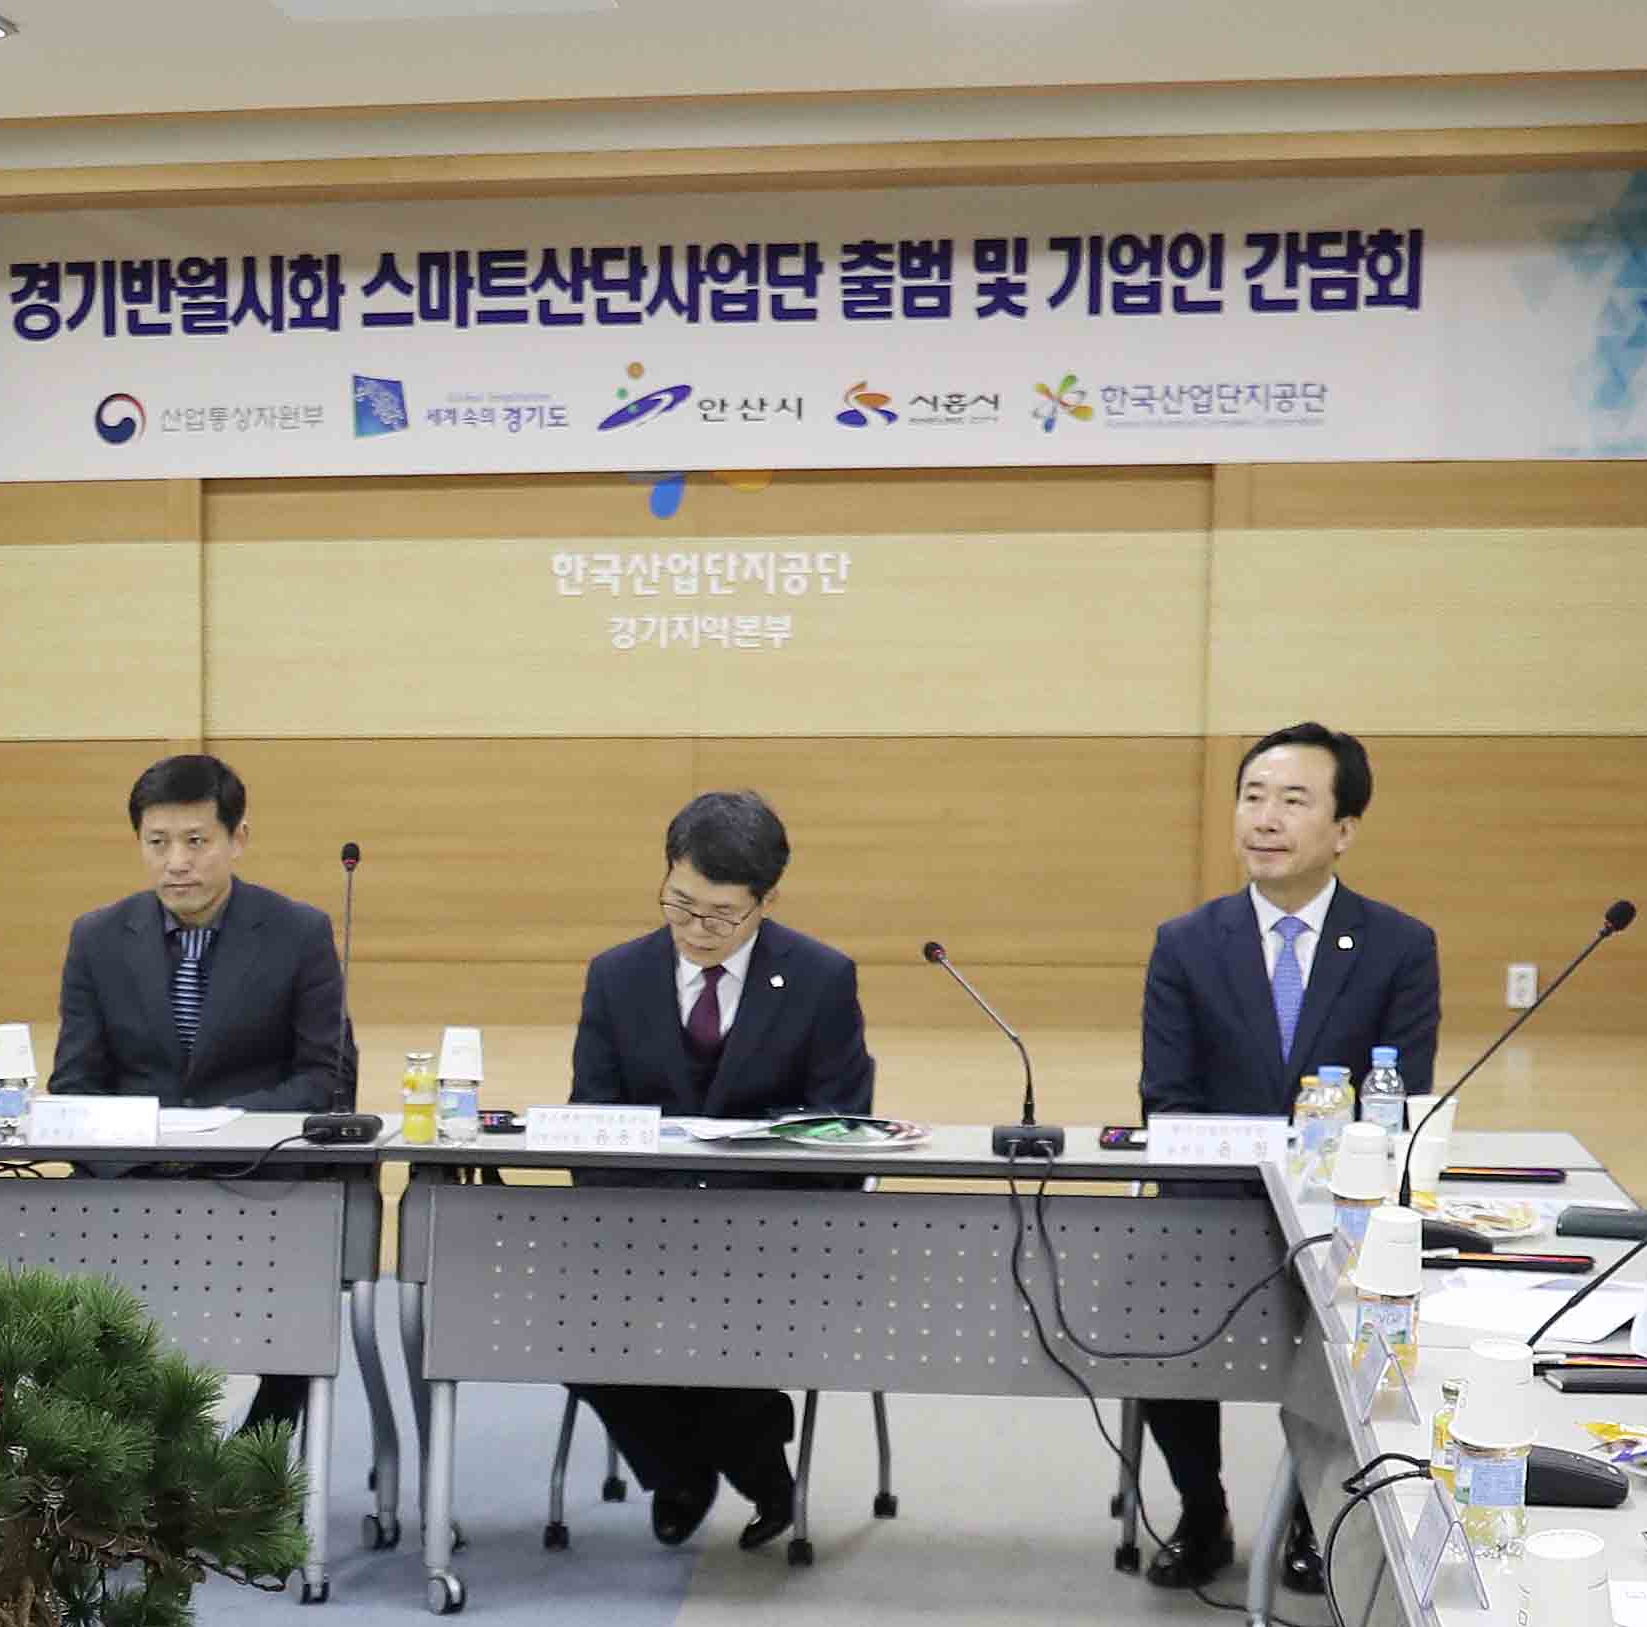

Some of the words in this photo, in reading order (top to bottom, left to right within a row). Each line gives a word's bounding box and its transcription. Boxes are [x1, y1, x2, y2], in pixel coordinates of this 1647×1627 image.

[9, 251, 346, 341] 경기반월시화
[361, 242, 822, 329] 스마트산단사업단
[839, 238, 954, 321] 출범
[972, 236, 1029, 320] 및
[1046, 230, 1225, 316] 기업인
[1242, 228, 1426, 312] 간담회
[698, 396, 803, 423] 안산시
[909, 392, 1000, 415] 시흥시
[1100, 383, 1329, 416] 한국산업단지공단
[160, 405, 324, 433] 산업통상자원부
[503, 405, 569, 433] 경기도
[552, 551, 852, 597] 한국산업단지공단
[609, 613, 795, 650] 경기지역본부
